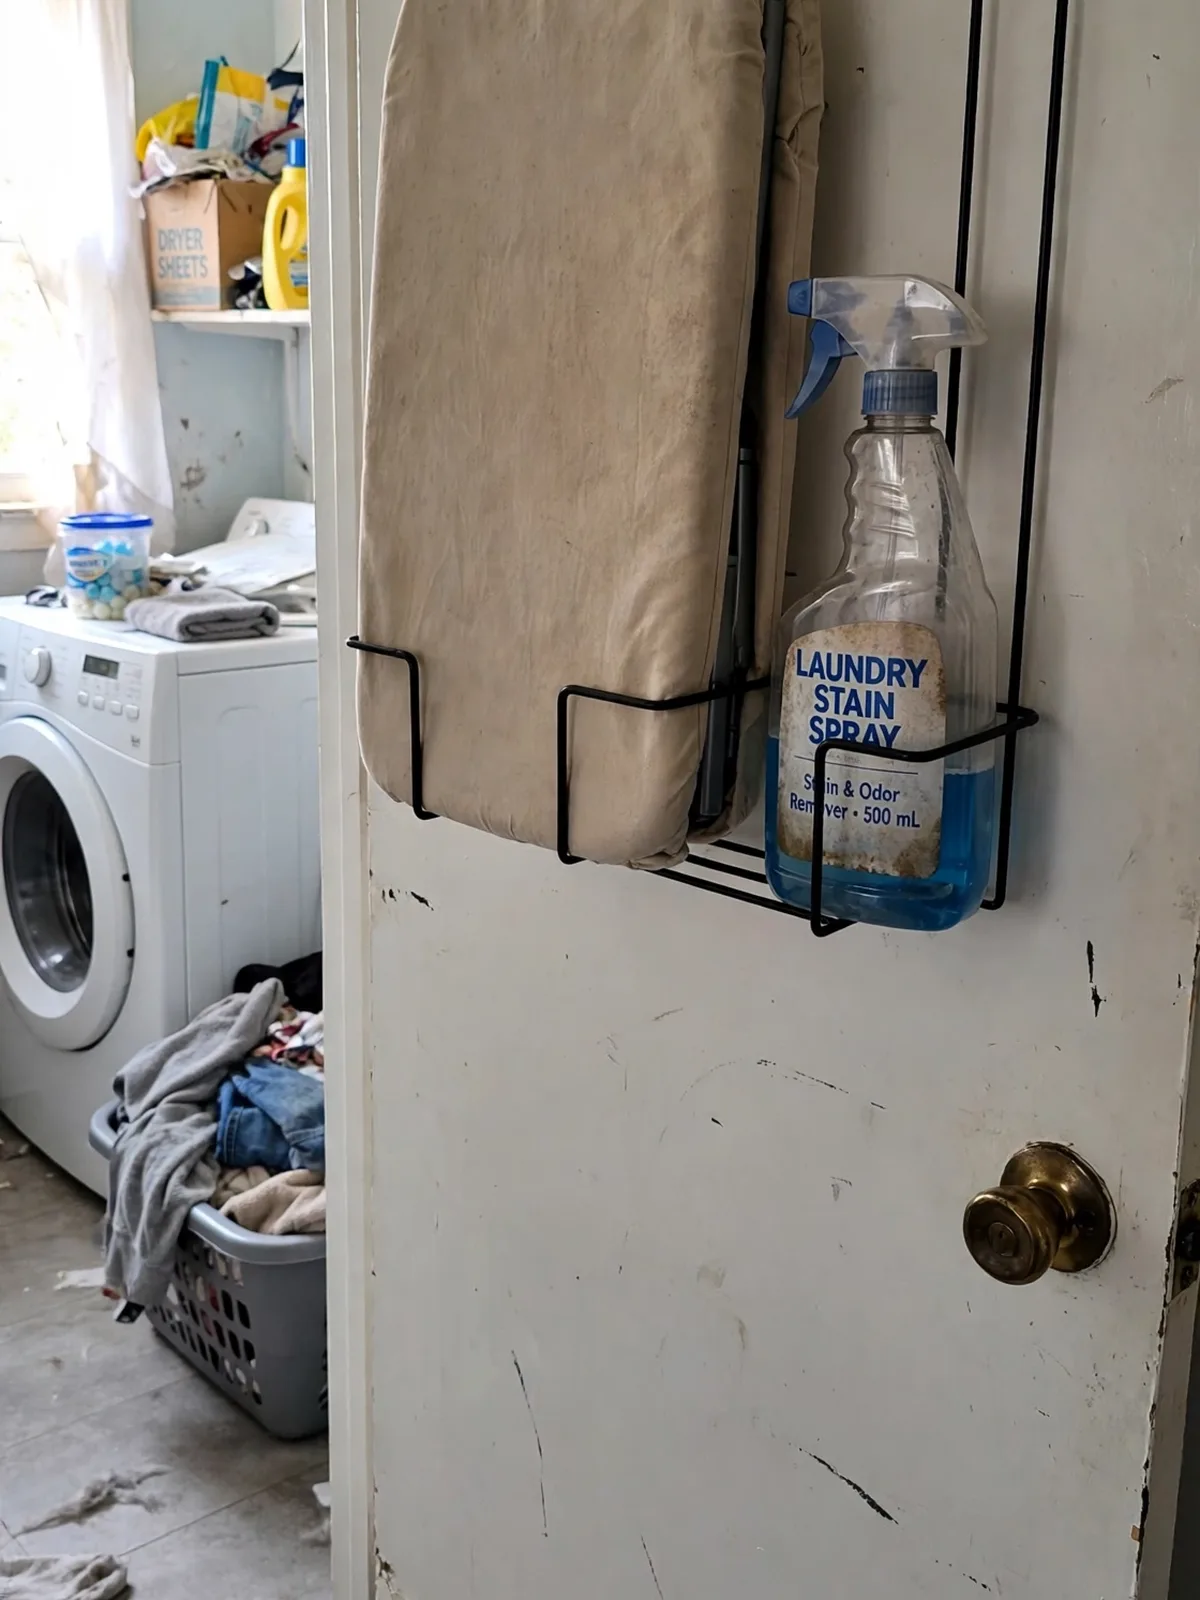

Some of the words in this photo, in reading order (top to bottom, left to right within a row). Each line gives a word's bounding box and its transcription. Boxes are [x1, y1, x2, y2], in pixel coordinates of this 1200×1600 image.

[158, 228, 204, 251] DRYER
[158, 254, 208, 279] SHEETS
[796, 648, 928, 688] LAUNDRY
[814, 684, 895, 720] STAIN
[809, 715, 901, 749] SPRAY
[804, 773, 838, 796] Stin
[843, 780, 854, 798] &
[859, 782, 900, 803] Odor
[790, 792, 848, 820] Remver
[863, 806, 891, 826] 500
[896, 810, 920, 828] mL
